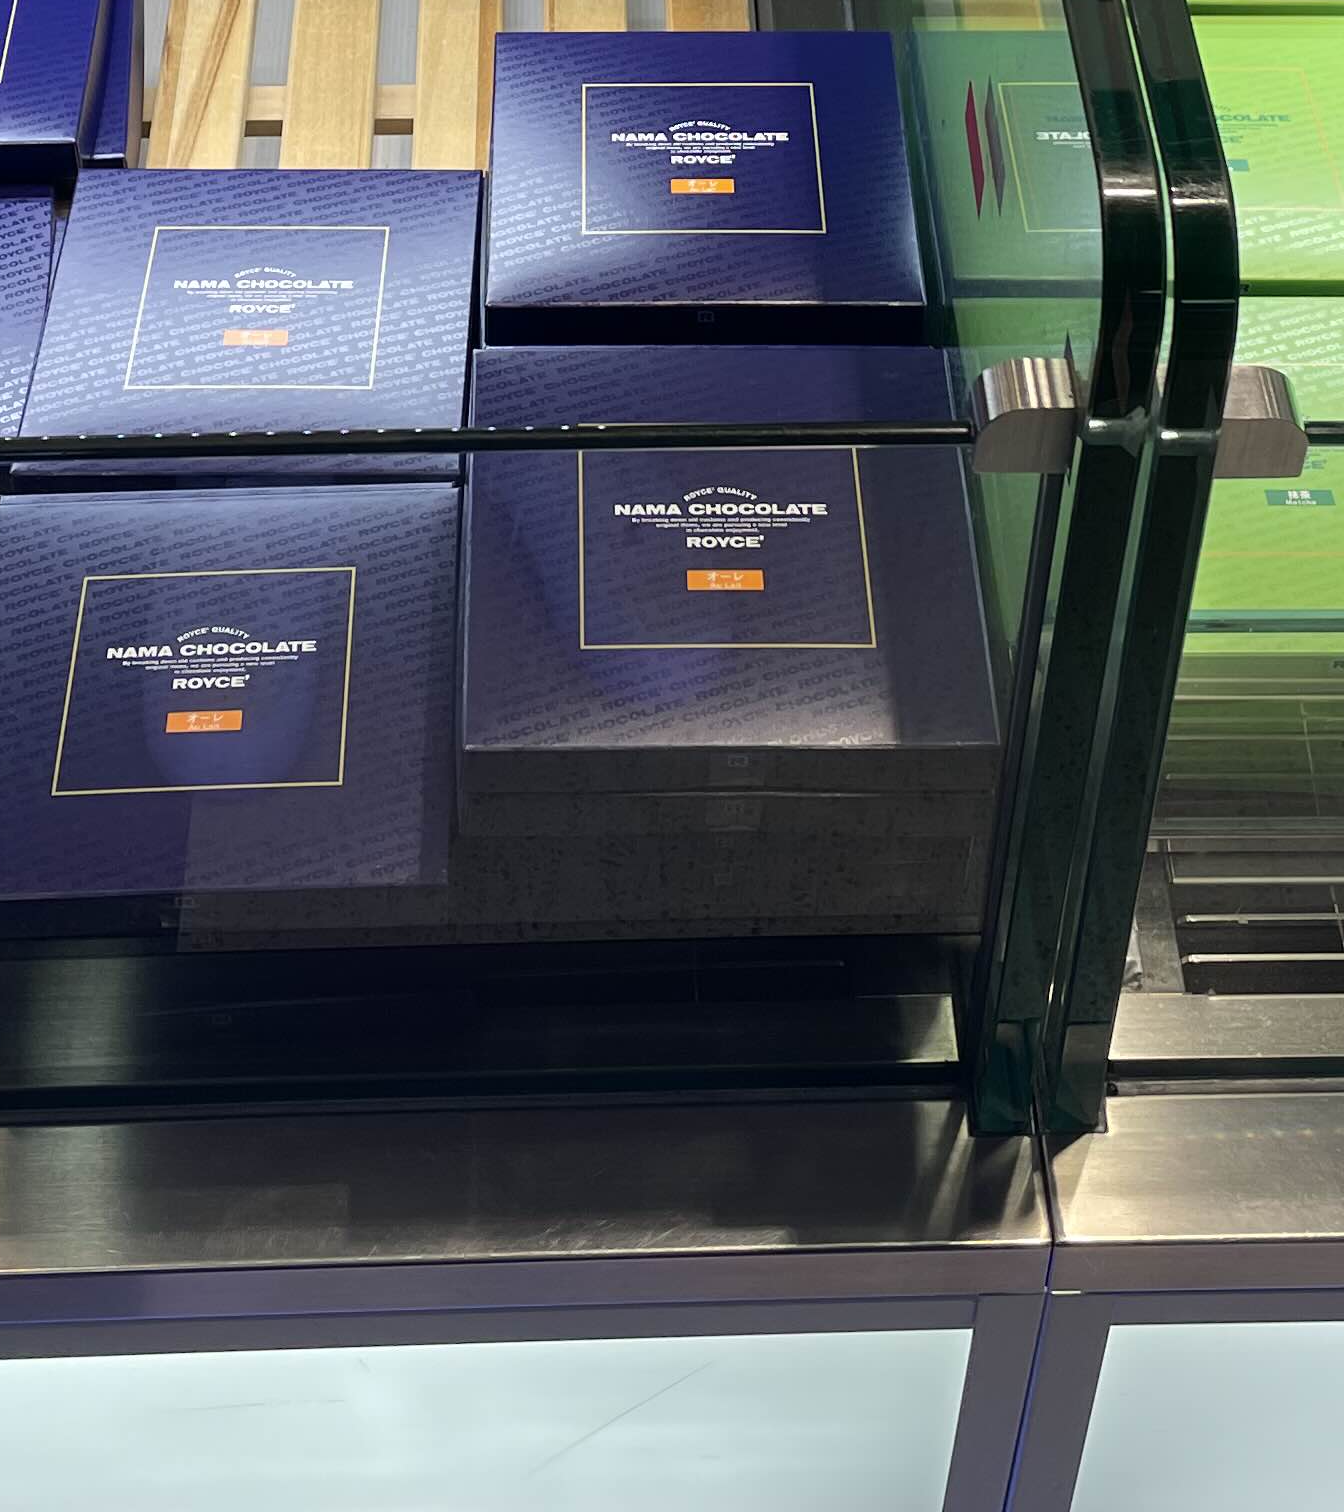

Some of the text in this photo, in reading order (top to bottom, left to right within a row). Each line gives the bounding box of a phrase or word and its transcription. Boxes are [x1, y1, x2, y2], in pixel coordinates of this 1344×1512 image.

[1218, 114, 1291, 122] COLATE
[611, 132, 789, 142] NAMA CHOCOLATE
[671, 154, 736, 164] ROYCE'
[174, 279, 353, 289] NAMA CHOCOLATE
[229, 303, 295, 314] ROYCE'
[614, 503, 828, 516] NAMA CHOCOLATE
[686, 535, 765, 548] ROYCE'
[707, 573, 744, 581] オーレ
[106, 640, 317, 659] NAMA CHOCOLATE
[172, 675, 250, 690] ROYCE'
[186, 713, 224, 722] オーレ
